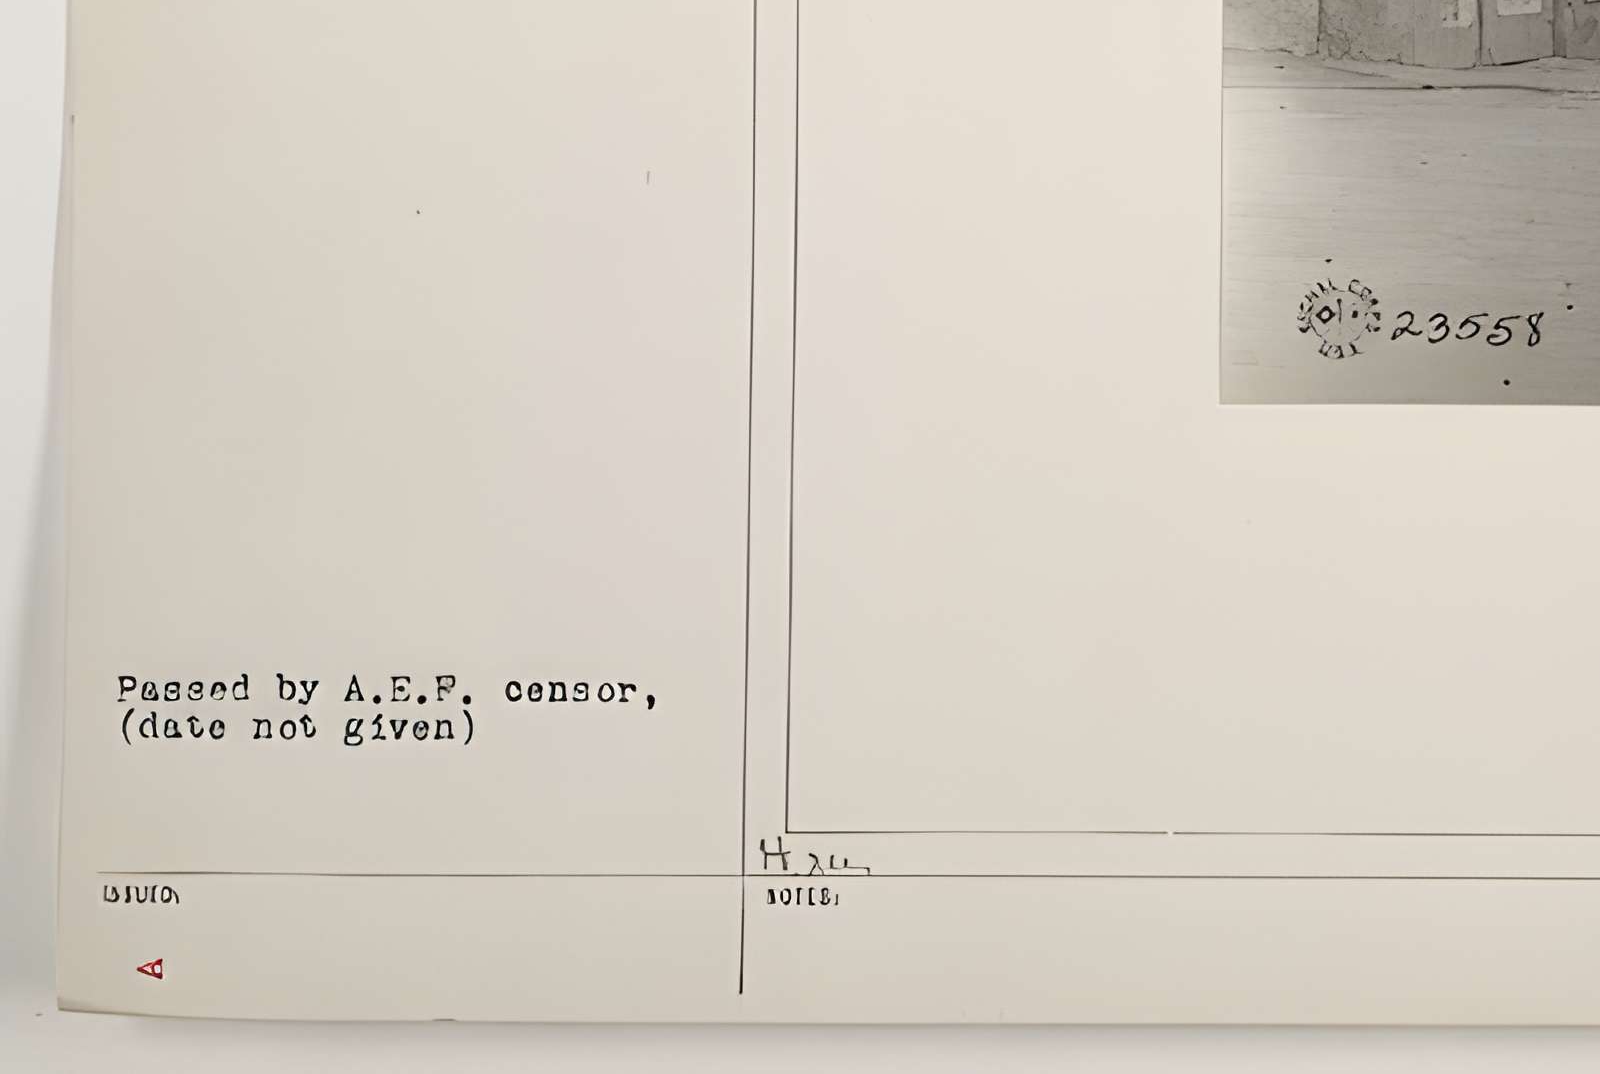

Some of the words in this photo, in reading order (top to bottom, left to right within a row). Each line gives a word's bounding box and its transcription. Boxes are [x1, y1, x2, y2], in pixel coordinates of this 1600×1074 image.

[117, 673, 251, 704] Passed
[276, 673, 321, 707] by
[344, 674, 473, 707] A.E.F.
[505, 681, 657, 712] censor,
[122, 707, 227, 747] (date
[252, 714, 318, 742] not
[344, 710, 475, 748] given)
